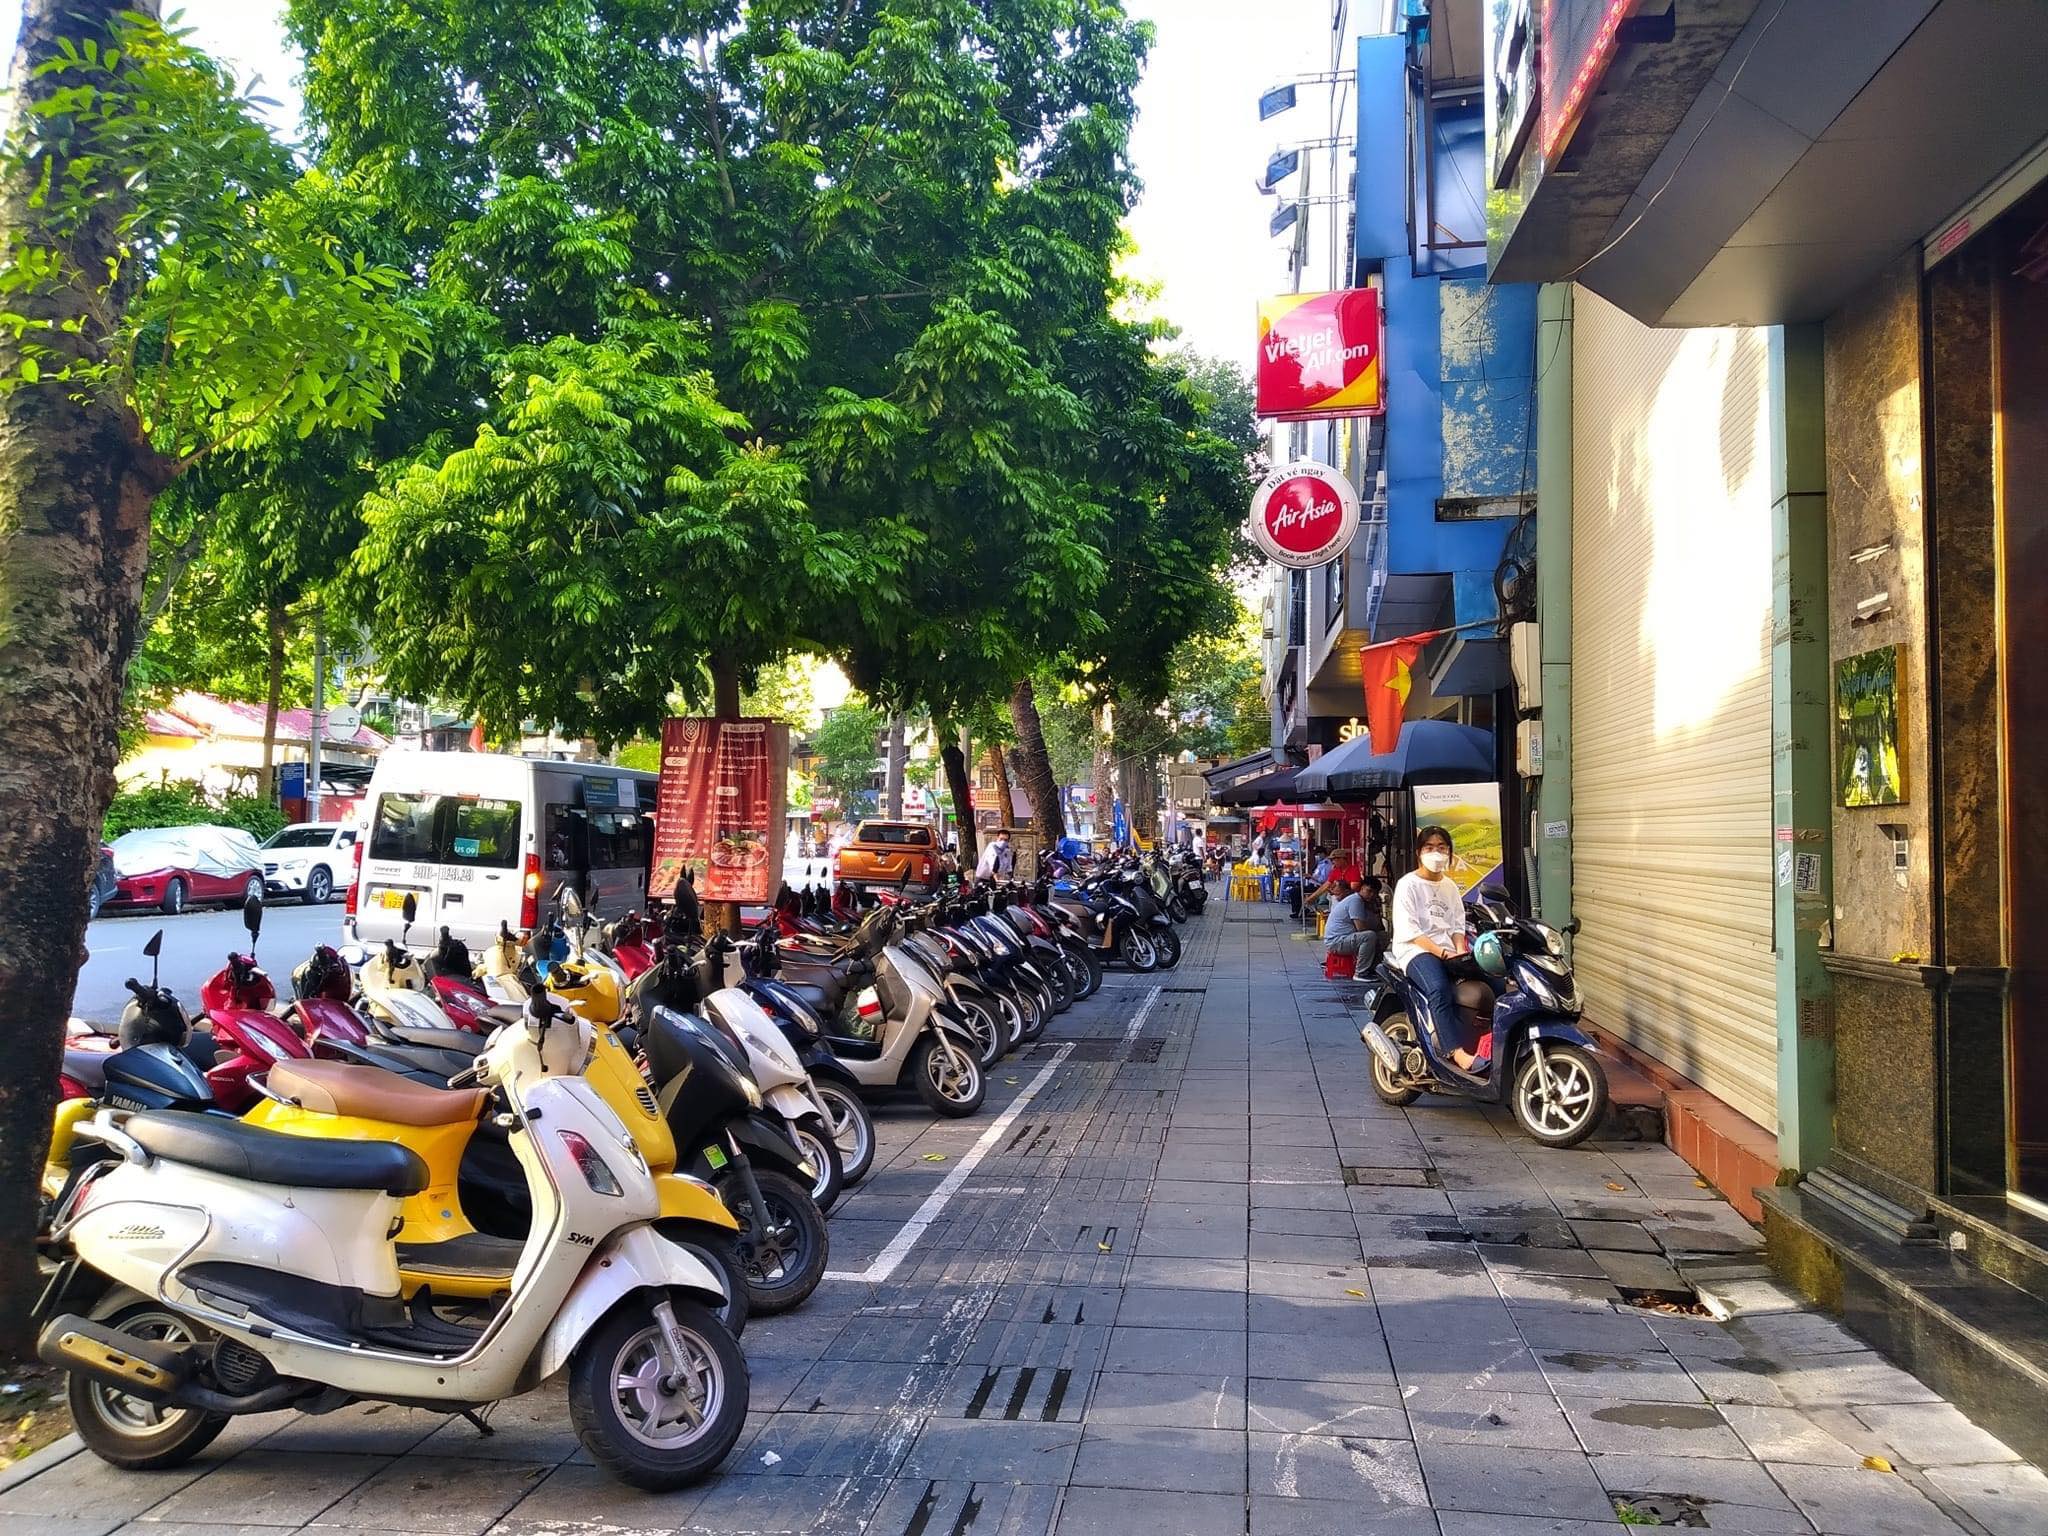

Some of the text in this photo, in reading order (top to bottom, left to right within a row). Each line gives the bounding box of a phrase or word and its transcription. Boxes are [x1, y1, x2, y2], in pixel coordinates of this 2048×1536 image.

[1300, 467, 1327, 477] ngay
[1278, 548, 1296, 560] Book
[1295, 553, 1312, 562] your
[1311, 548, 1330, 560] flight
[465, 846, 476, 854] 09
[210, 1075, 235, 1083] HONDA
[567, 1232, 595, 1246] SYM
